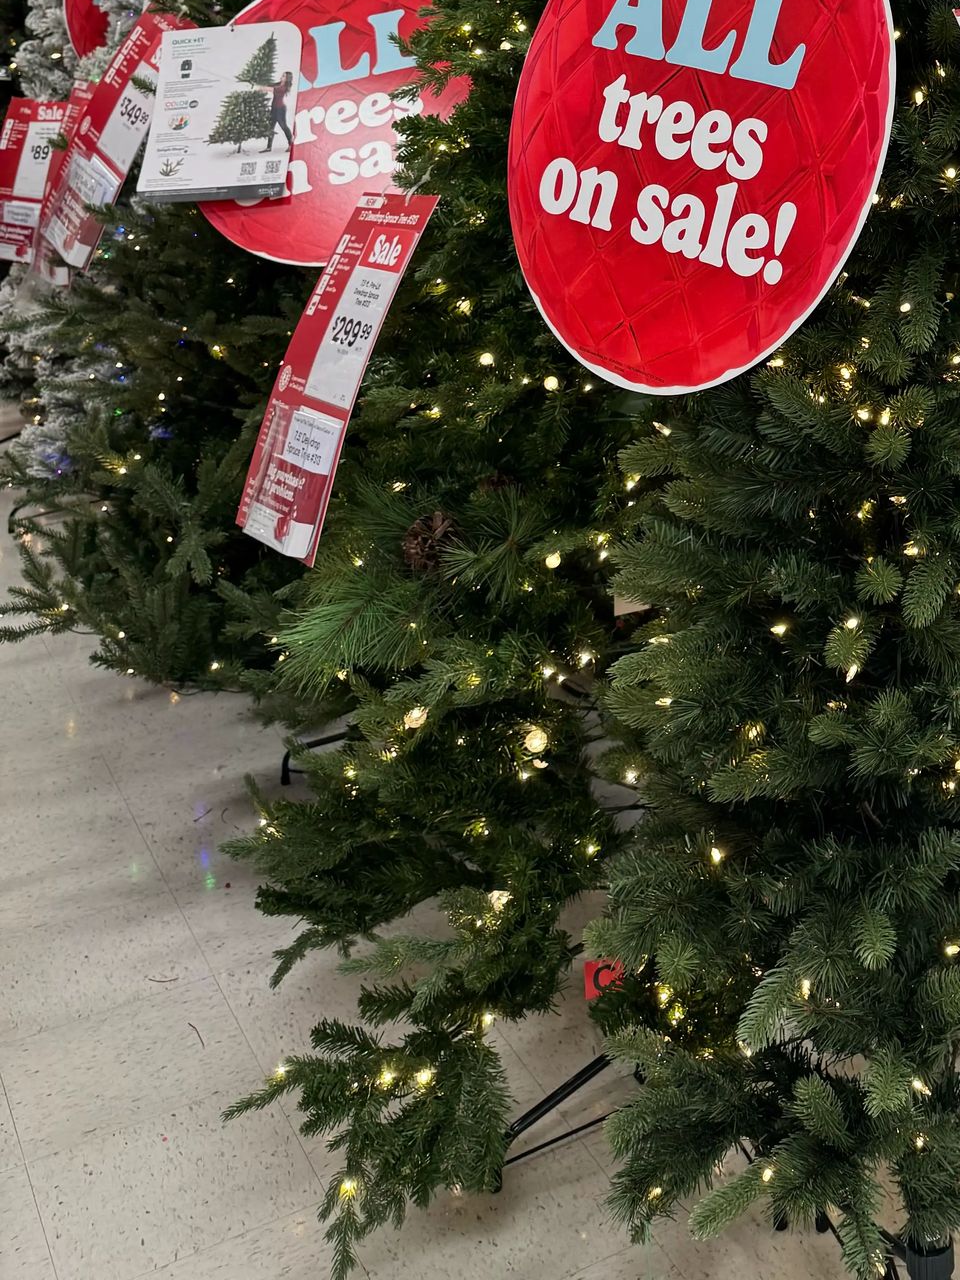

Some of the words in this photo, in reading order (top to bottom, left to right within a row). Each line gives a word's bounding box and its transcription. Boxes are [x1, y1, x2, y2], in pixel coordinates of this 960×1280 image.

[298, 9, 417, 92] LL
[37, 105, 64, 121] Sale
[598, 73, 769, 182] trees
[368, 234, 402, 266] Sale
[539, 157, 619, 232] on
[631, 181, 799, 286] sale!
